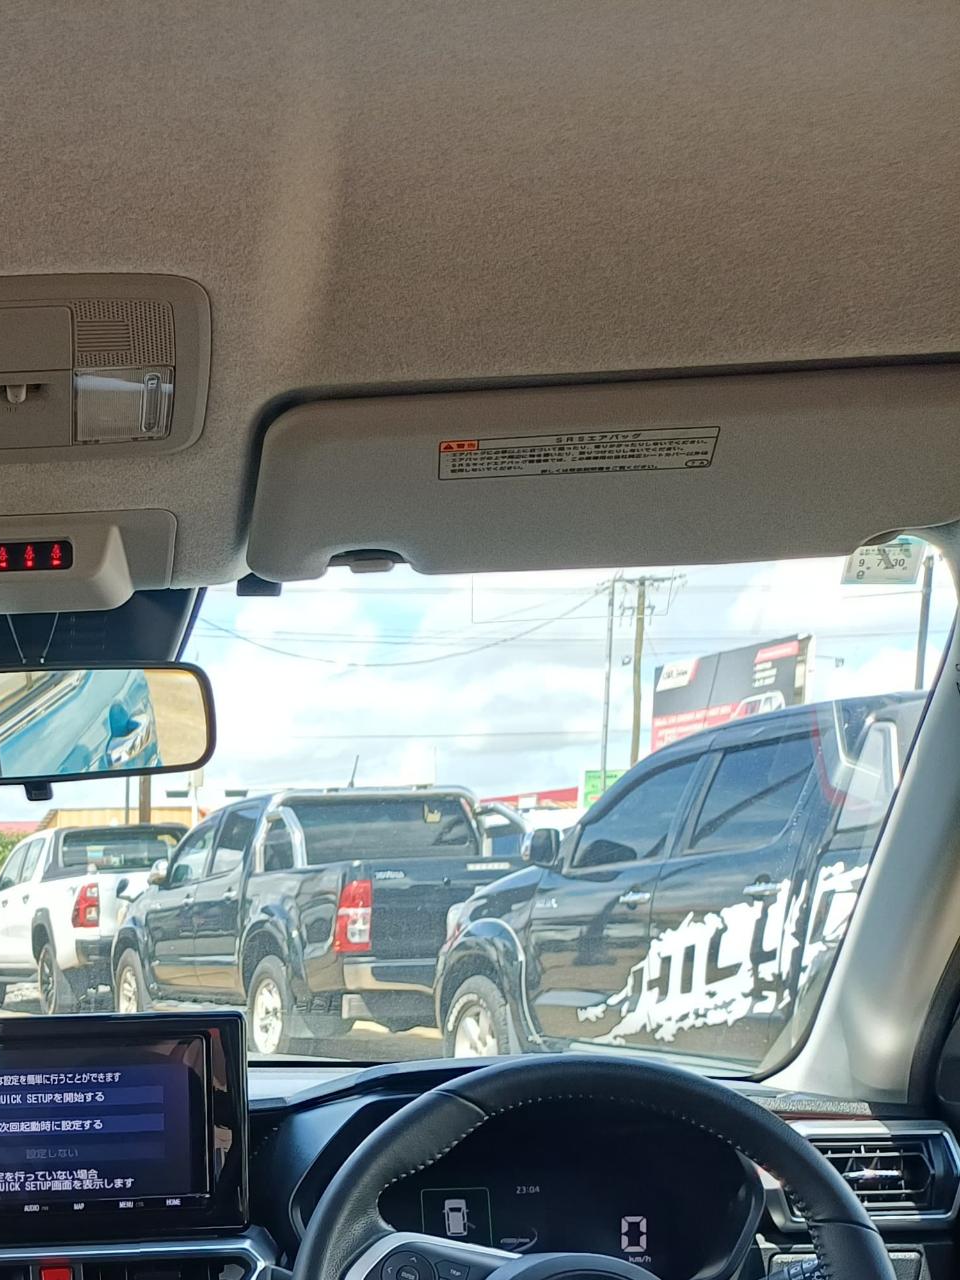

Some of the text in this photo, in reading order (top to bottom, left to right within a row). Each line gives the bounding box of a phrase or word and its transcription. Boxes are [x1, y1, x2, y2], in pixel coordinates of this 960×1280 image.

[27, 1091, 104, 1104] SETUPを開始する
[0, 1119, 103, 1132] 次回起動時に設定する
[26, 1148, 79, 1160] 設定しない
[25, 1178, 134, 1192] SETUP画面を表示します
[516, 1186, 540, 1194] 23:04
[119, 1201, 134, 1209] MENU
[166, 1198, 181, 1206] HOME
[24, 1204, 39, 1212] AUDIO
[621, 1216, 647, 1252] 0
[629, 1255, 651, 1264] km/h
